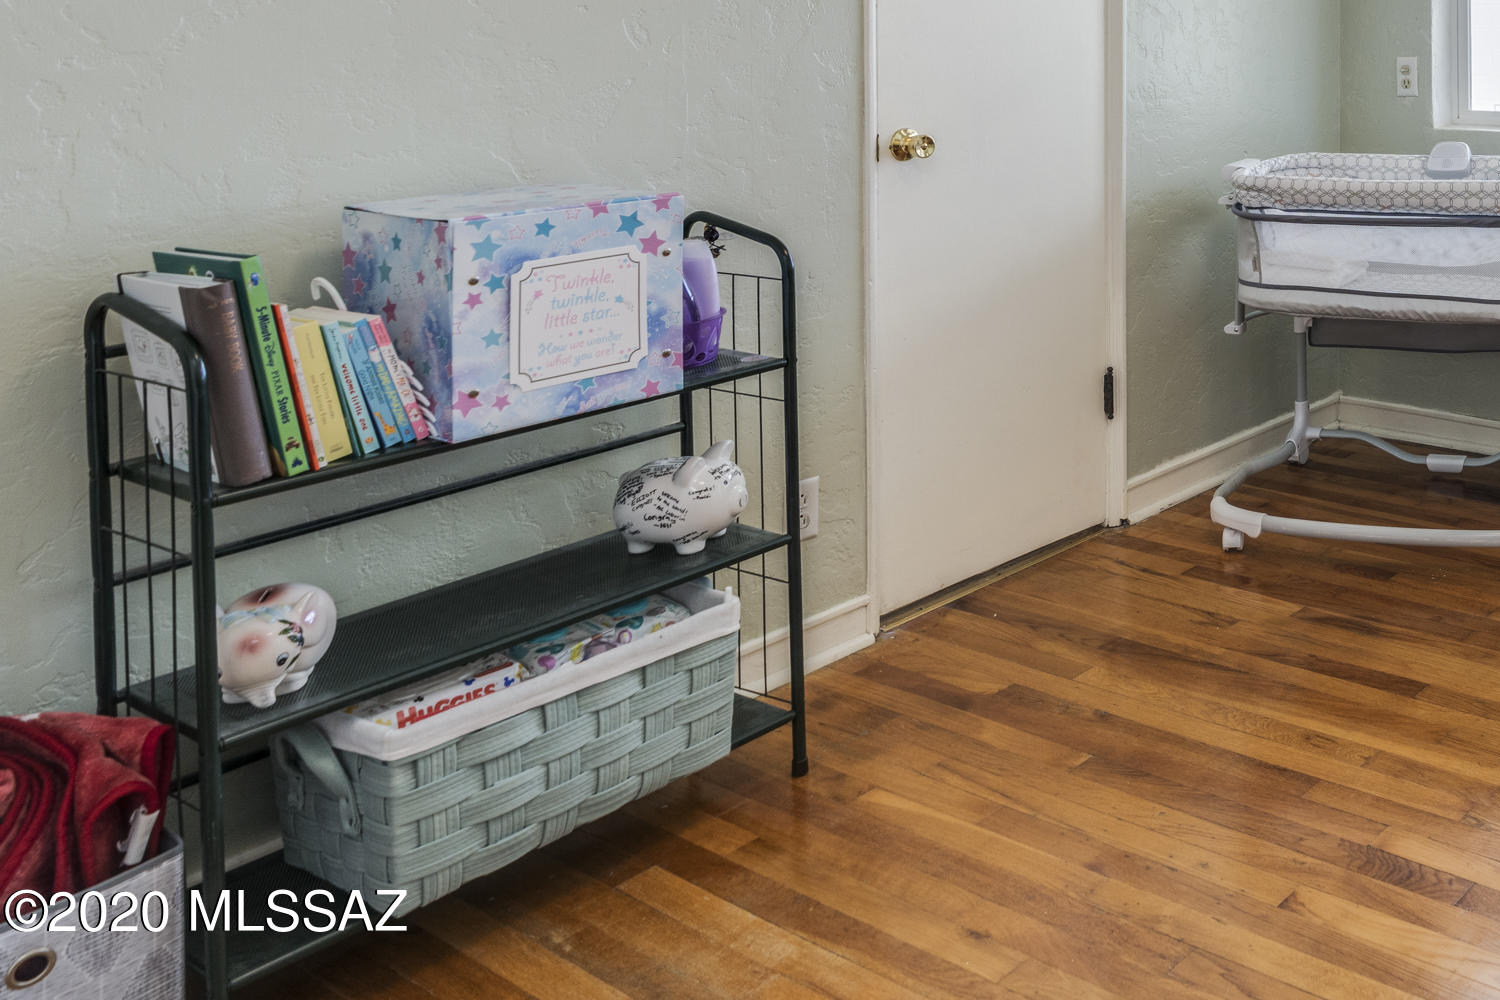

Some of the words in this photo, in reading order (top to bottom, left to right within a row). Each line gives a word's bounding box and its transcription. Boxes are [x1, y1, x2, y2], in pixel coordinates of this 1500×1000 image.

[220, 311, 239, 338] BABY
[256, 306, 272, 342] 5-Minute
[544, 309, 578, 330] little
[538, 342, 567, 356] How
[570, 340, 584, 350] we
[586, 331, 623, 346] wonder
[228, 342, 245, 373] BOOK
[545, 353, 572, 368] what
[573, 353, 593, 367] you
[271, 369, 284, 396] PIXAR
[277, 395, 290, 424] Stories
[342, 363, 354, 394] welcome
[351, 394, 362, 416] little
[359, 418, 368, 431] one
